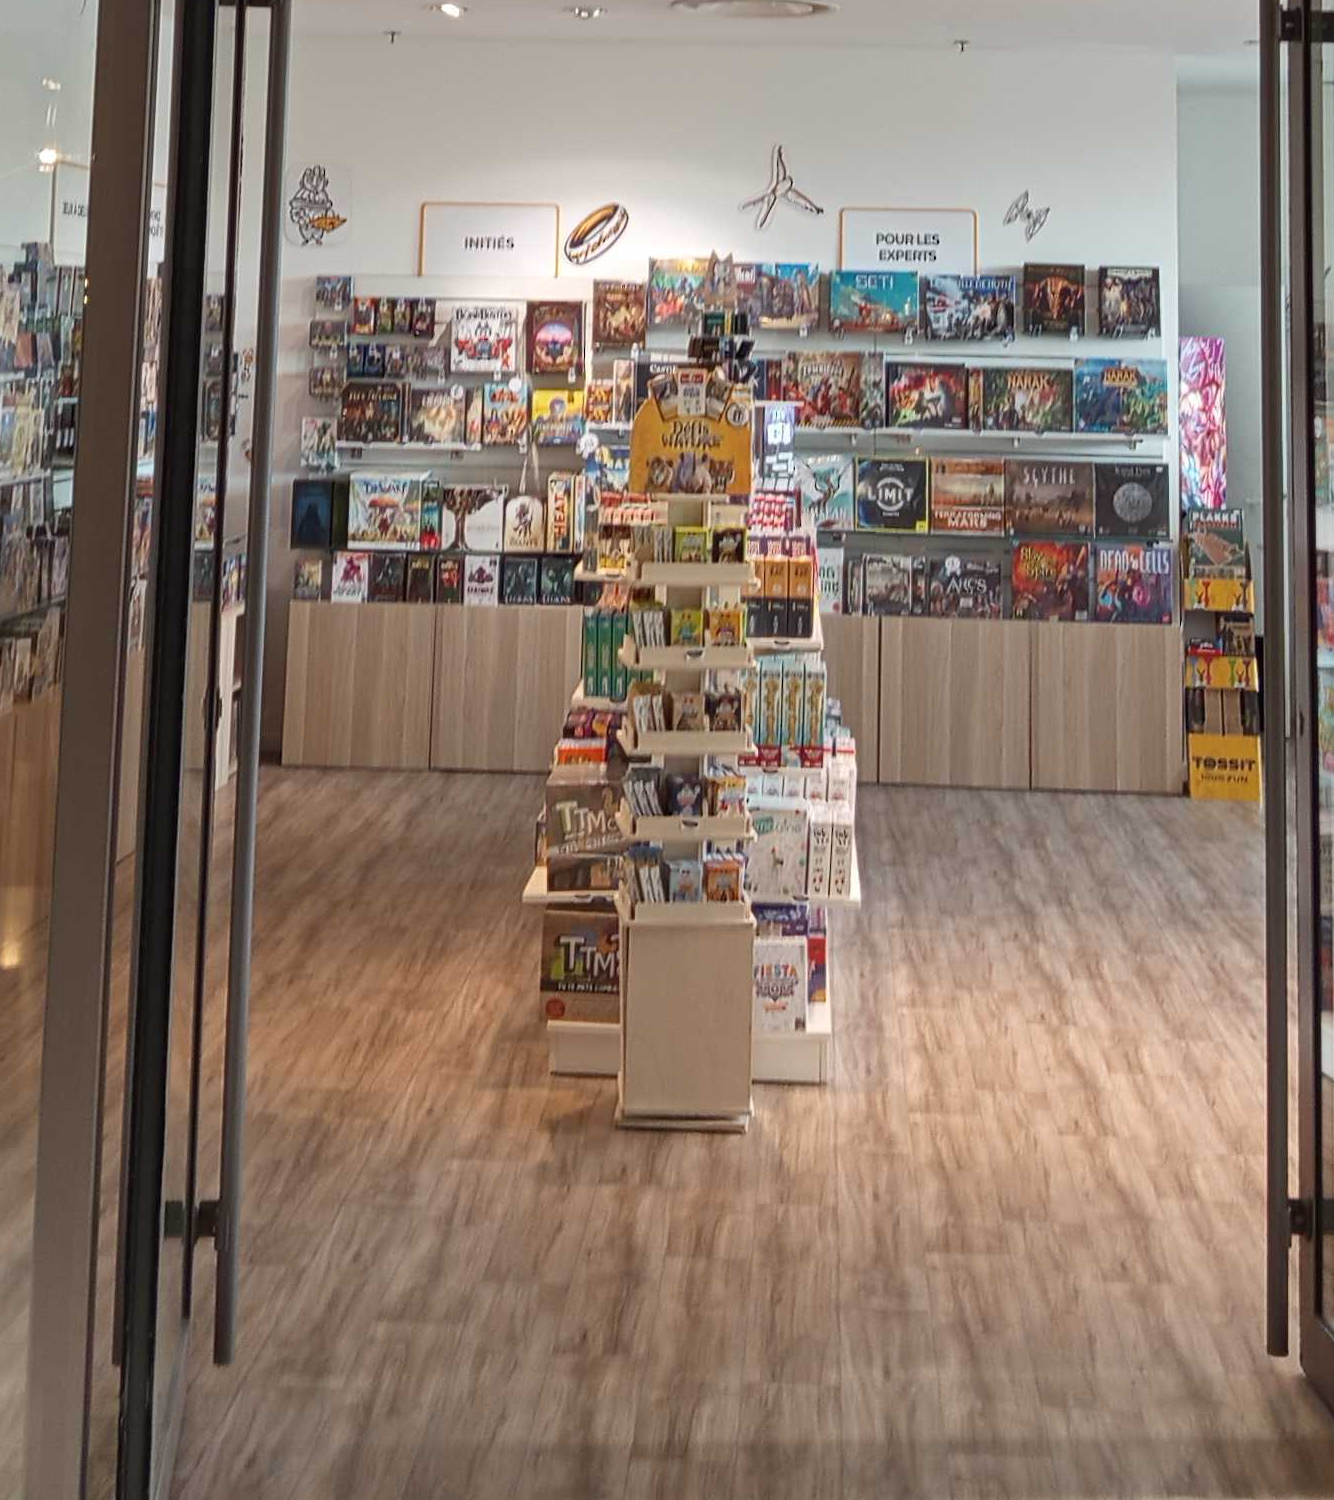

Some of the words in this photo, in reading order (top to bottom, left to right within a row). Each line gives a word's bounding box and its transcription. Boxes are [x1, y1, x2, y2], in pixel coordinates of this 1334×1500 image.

[463, 234, 516, 250] INITIÉS
[875, 232, 913, 246] POUR
[915, 232, 940, 247] LES
[878, 250, 937, 262] EXPERTS
[1023, 465, 1076, 488] SCYTHE
[867, 487, 914, 503] LIMIT
[947, 517, 987, 529] MARS
[1139, 551, 1170, 575] CELLS
[945, 577, 987, 595] ARCS
[1192, 756, 1256, 772] TOSSIT
